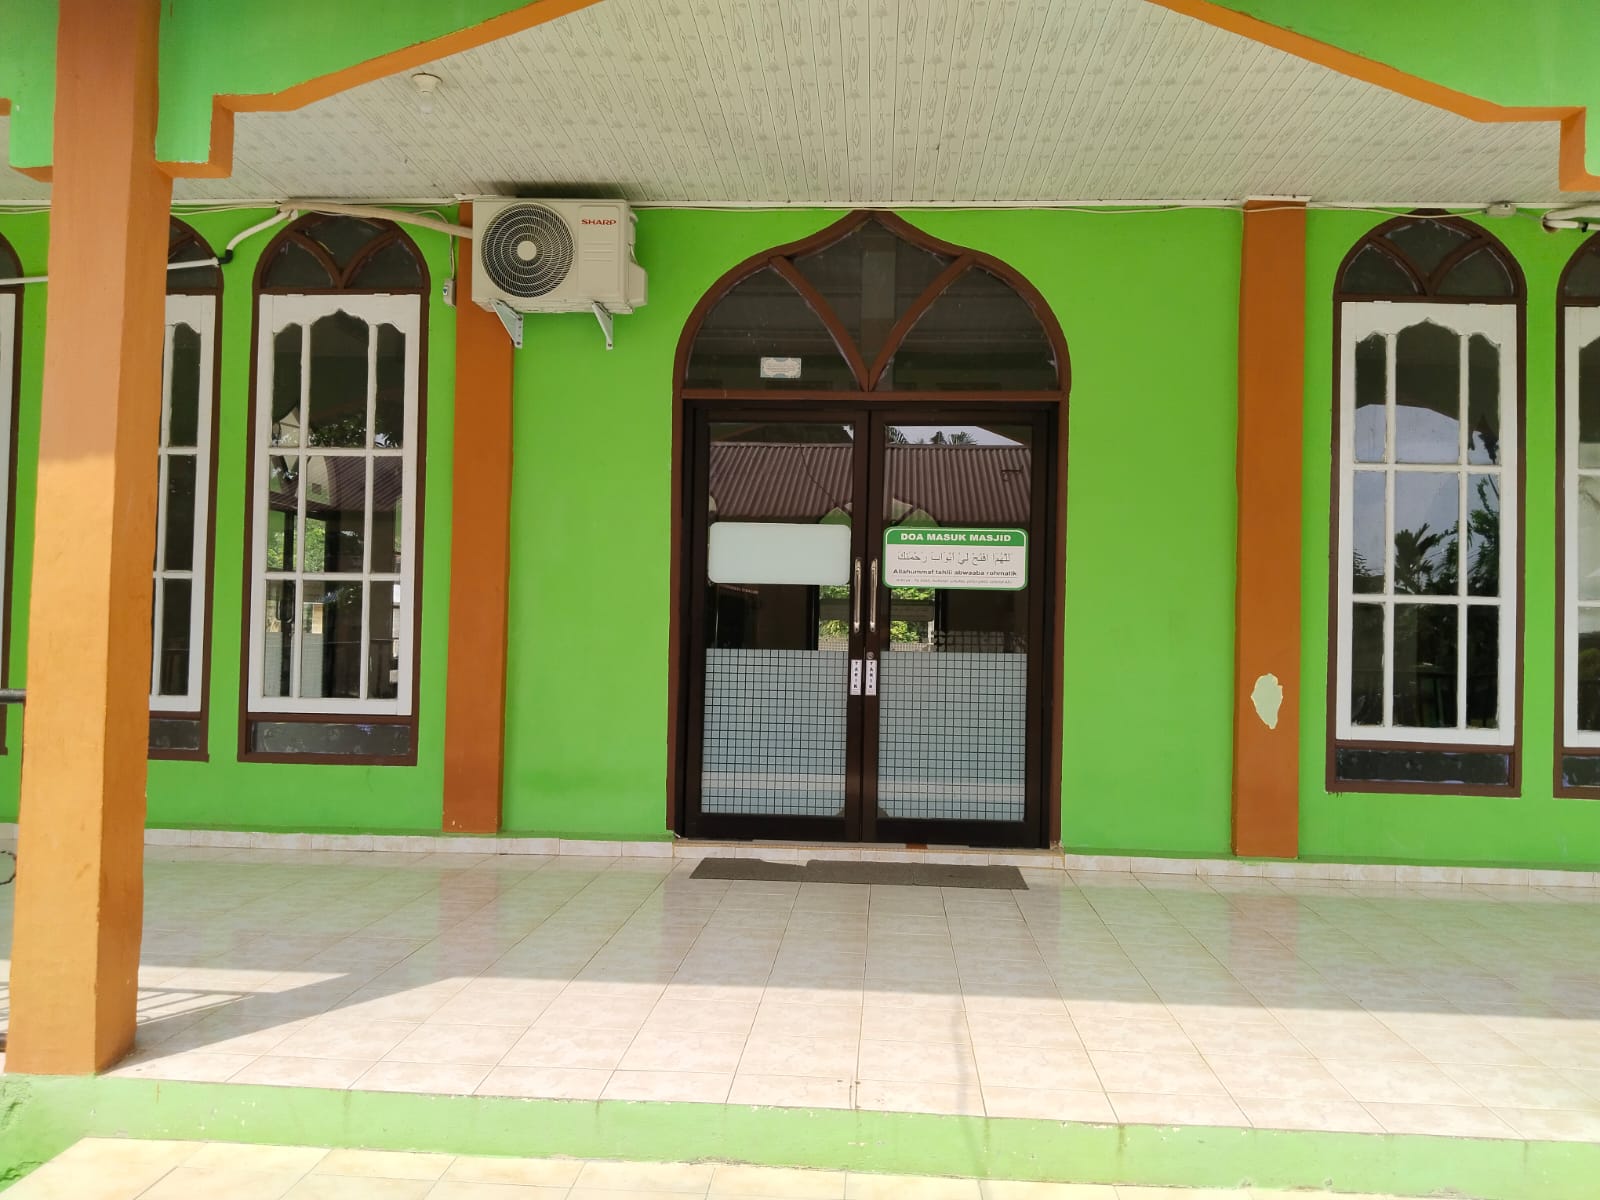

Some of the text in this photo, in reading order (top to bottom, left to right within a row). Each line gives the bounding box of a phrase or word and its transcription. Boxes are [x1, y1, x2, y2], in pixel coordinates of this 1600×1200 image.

[900, 533, 1012, 542] DOA MASUK MASJID
